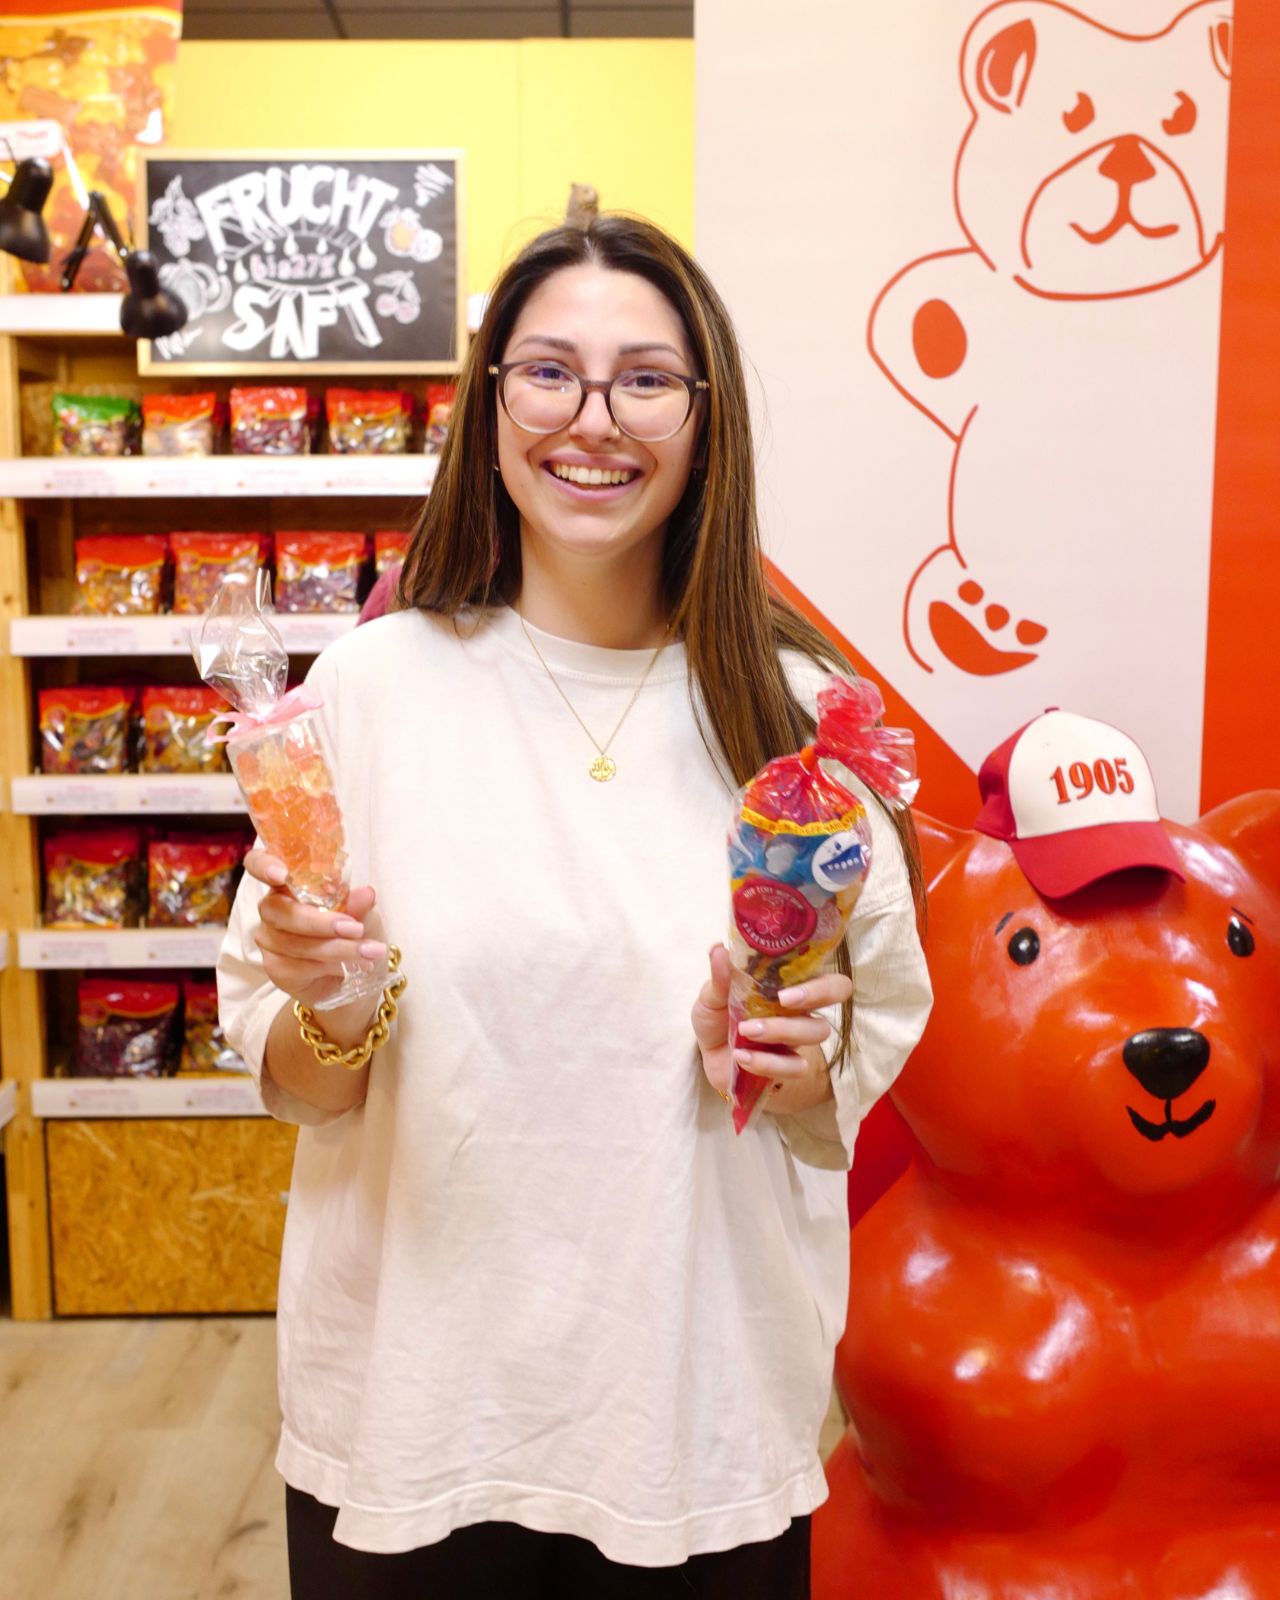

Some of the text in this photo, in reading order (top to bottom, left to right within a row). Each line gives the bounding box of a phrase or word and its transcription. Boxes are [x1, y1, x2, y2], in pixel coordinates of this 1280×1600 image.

[195, 164, 399, 255] FRUCHT
[221, 285, 383, 359] SAFT
[1049, 757, 1135, 806] 1905
[827, 857, 860, 871] vegan
